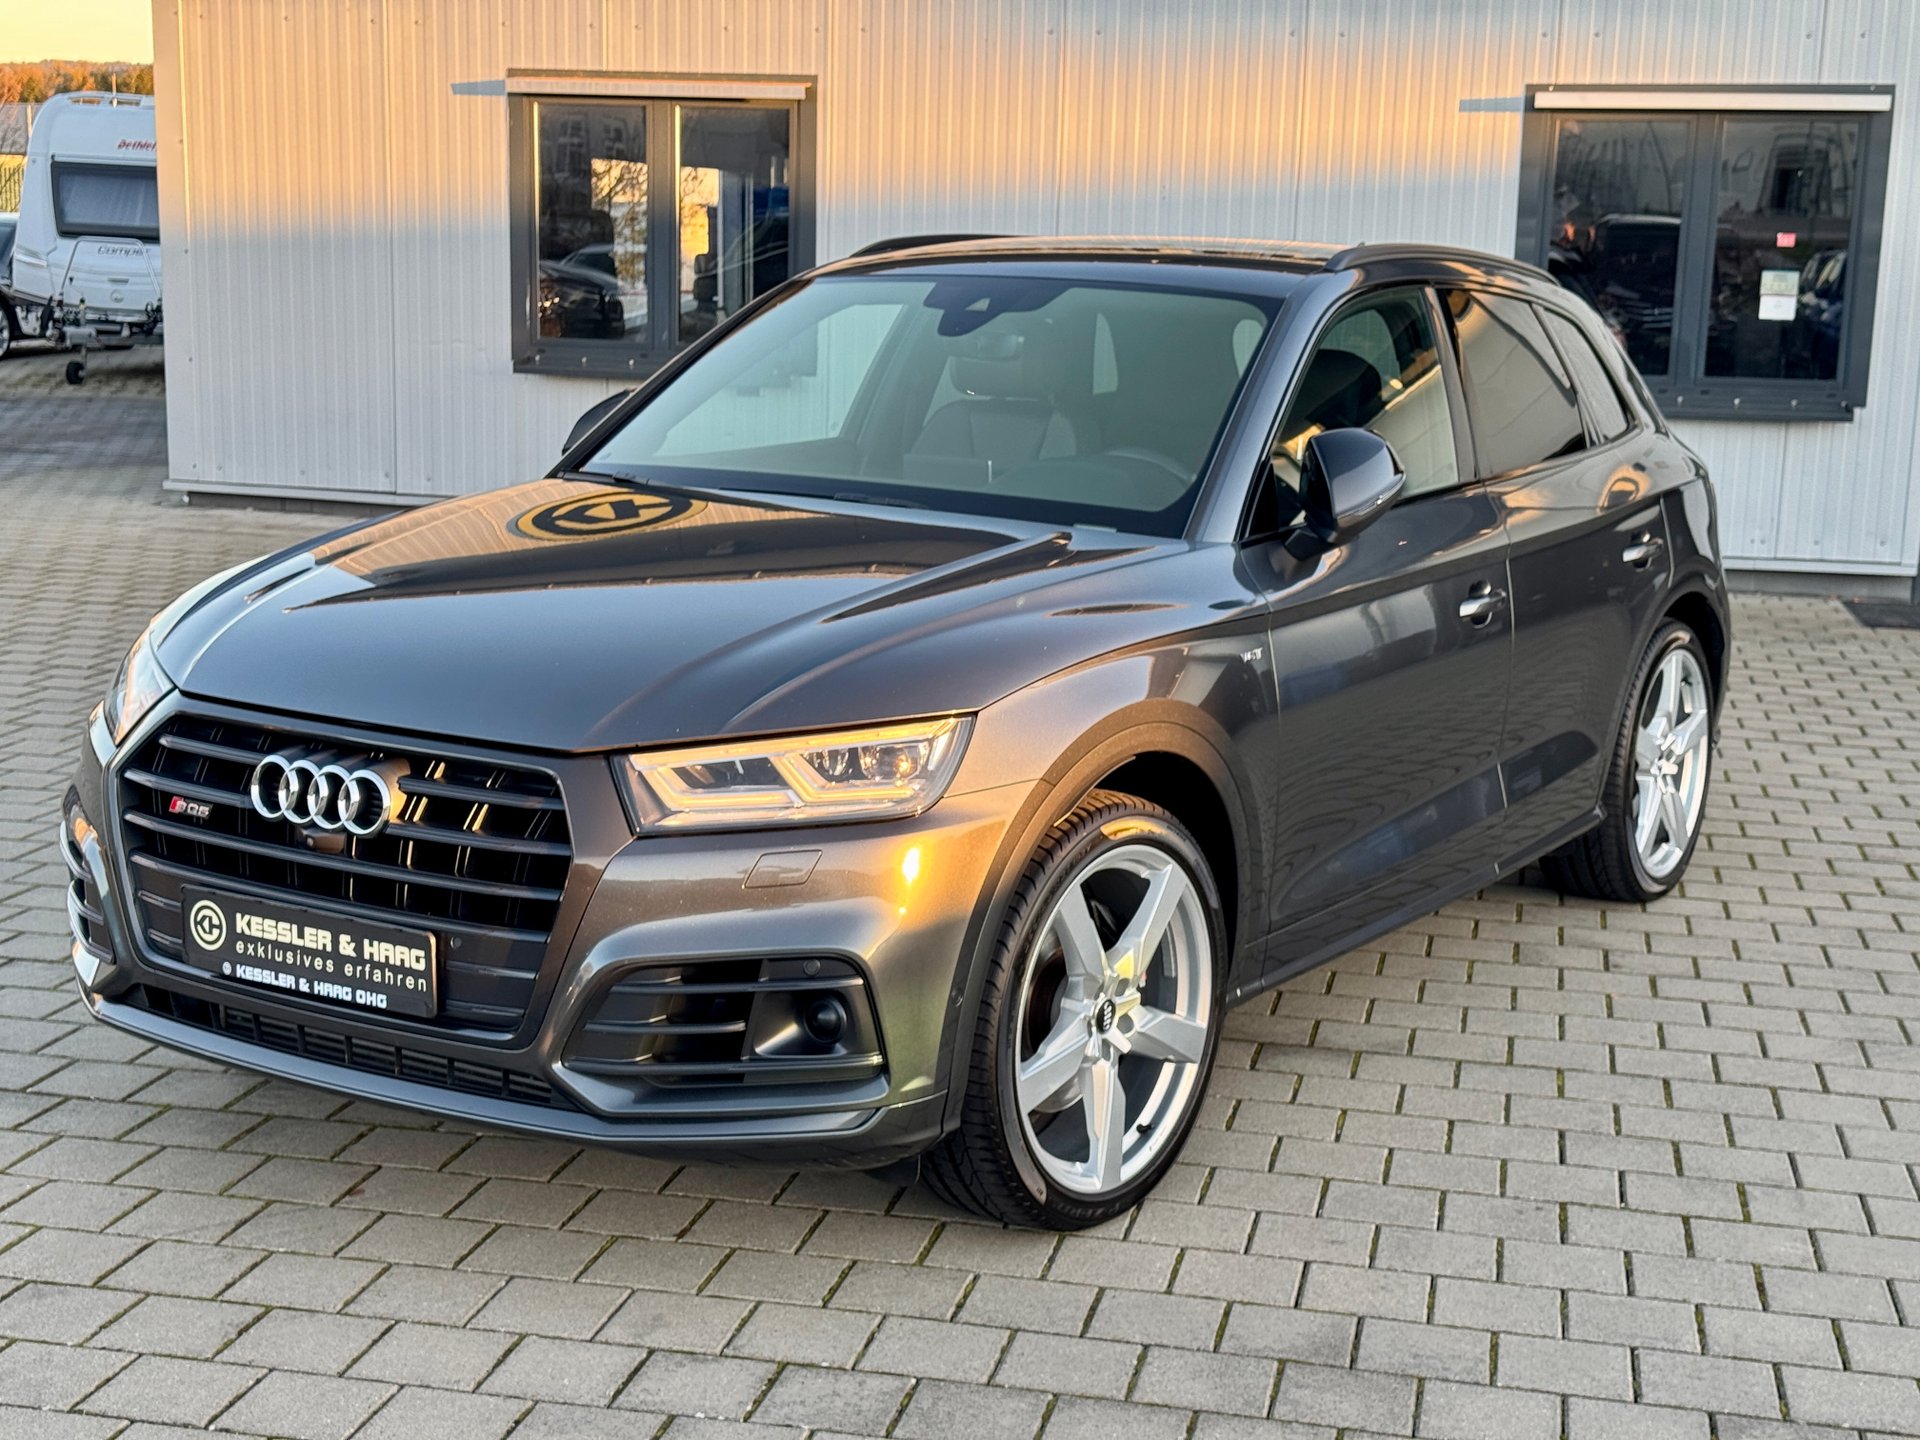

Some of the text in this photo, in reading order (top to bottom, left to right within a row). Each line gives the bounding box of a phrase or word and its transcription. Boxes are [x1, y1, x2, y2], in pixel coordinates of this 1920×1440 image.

[235, 912, 426, 972] KESSLER & HAAG
[235, 940, 427, 993] exklusives erfahren
[235, 963, 388, 1009] KESSLER & HAAG OHG
